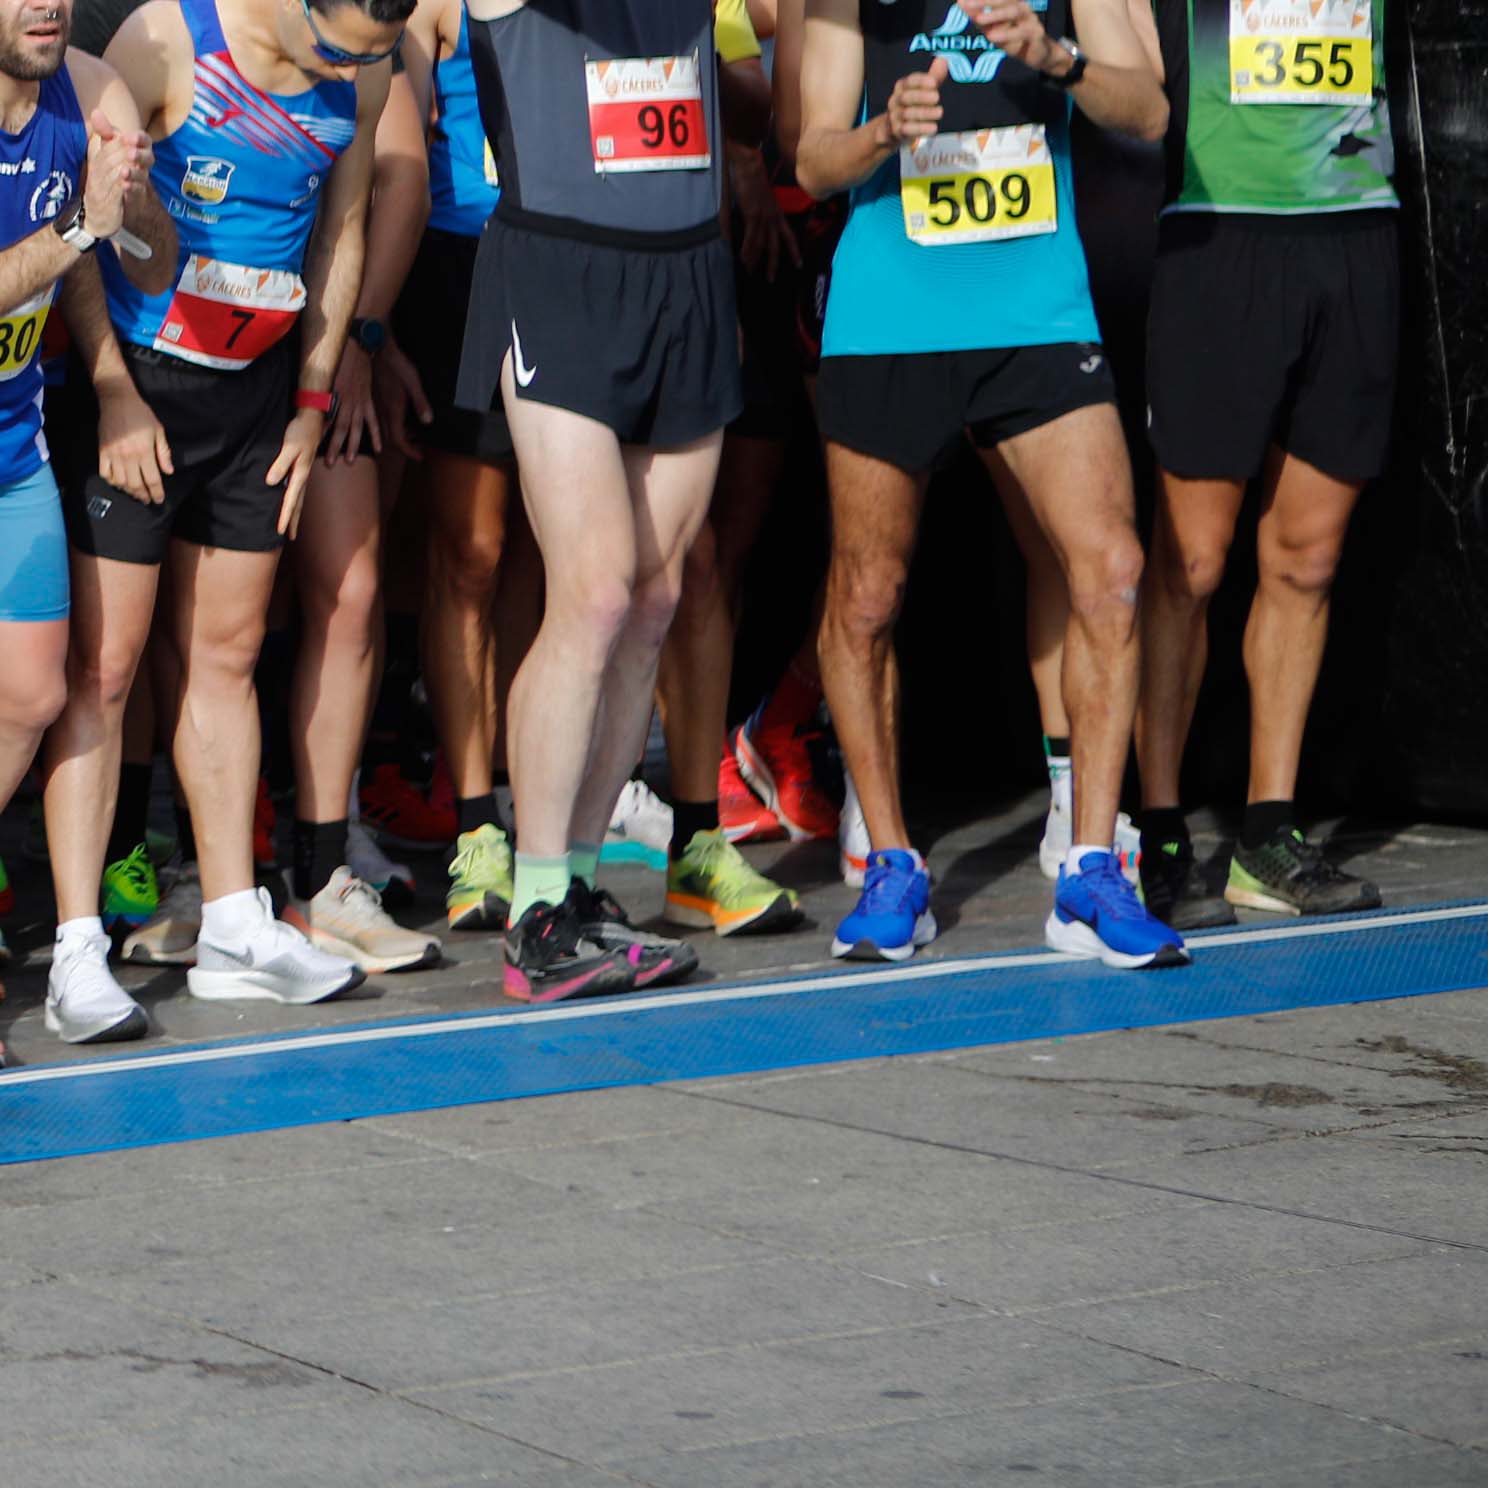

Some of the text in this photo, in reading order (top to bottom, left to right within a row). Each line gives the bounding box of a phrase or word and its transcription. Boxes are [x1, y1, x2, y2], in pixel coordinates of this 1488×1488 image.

[908, 32, 996, 53] ANDIA
[1254, 40, 1354, 87] 355
[637, 104, 689, 149] 96
[927, 173, 1031, 227] 509
[226, 309, 255, 350] 7
